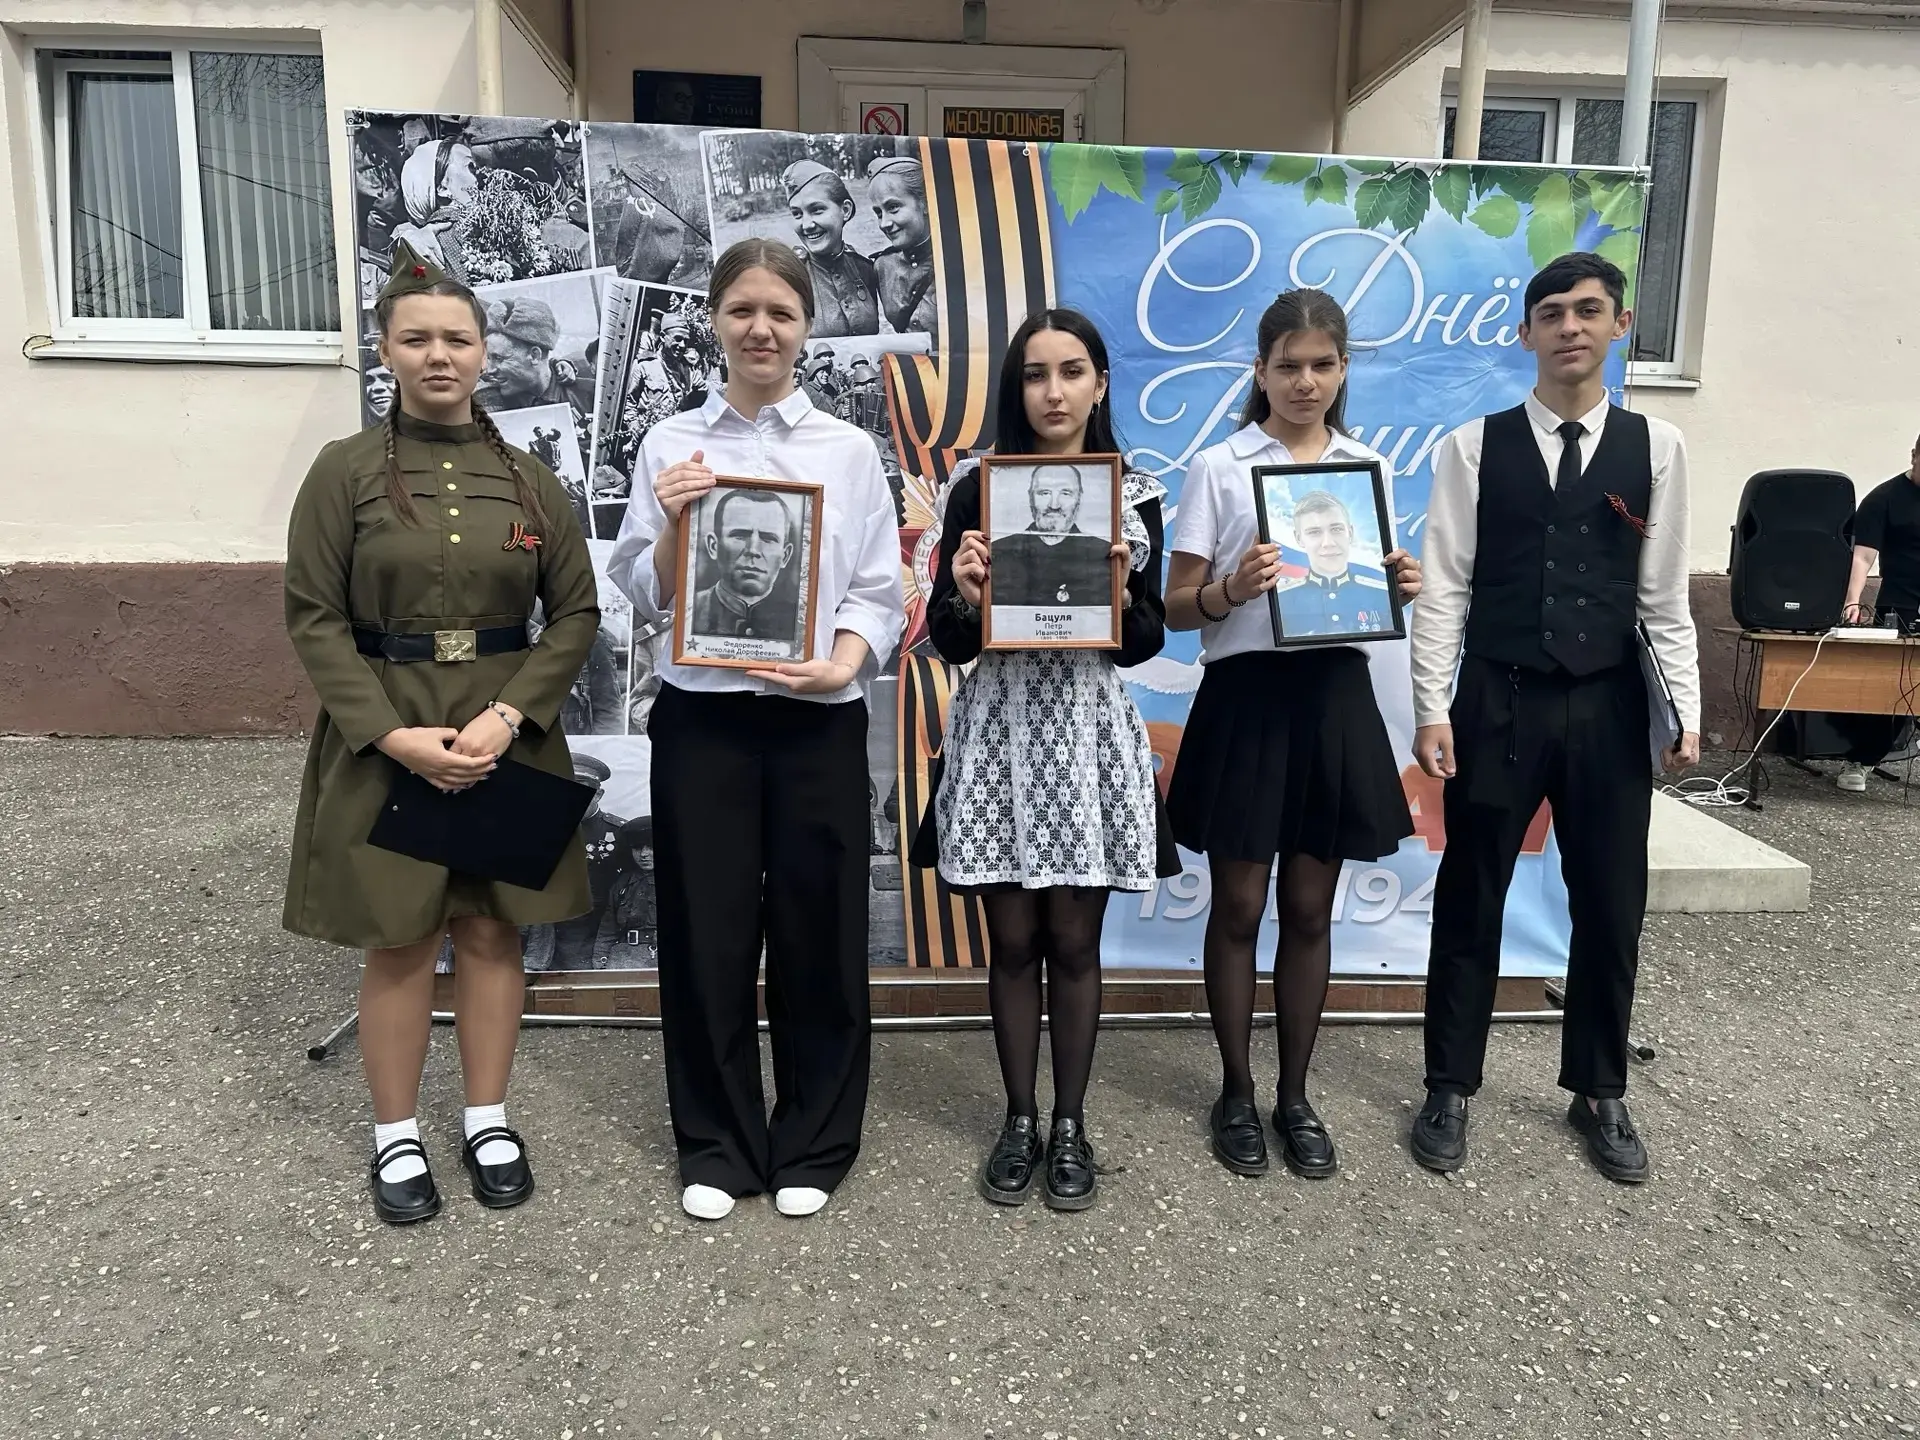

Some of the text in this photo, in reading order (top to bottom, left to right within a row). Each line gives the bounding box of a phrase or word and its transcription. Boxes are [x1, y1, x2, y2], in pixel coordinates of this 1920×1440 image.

[945, 109, 991, 134] МБОУ
[1135, 214, 1262, 353] С
[1035, 613, 1072, 622] Бацуля
[723, 640, 764, 649] Федоренко
[704, 646, 781, 658] Николай Дорофеевич
